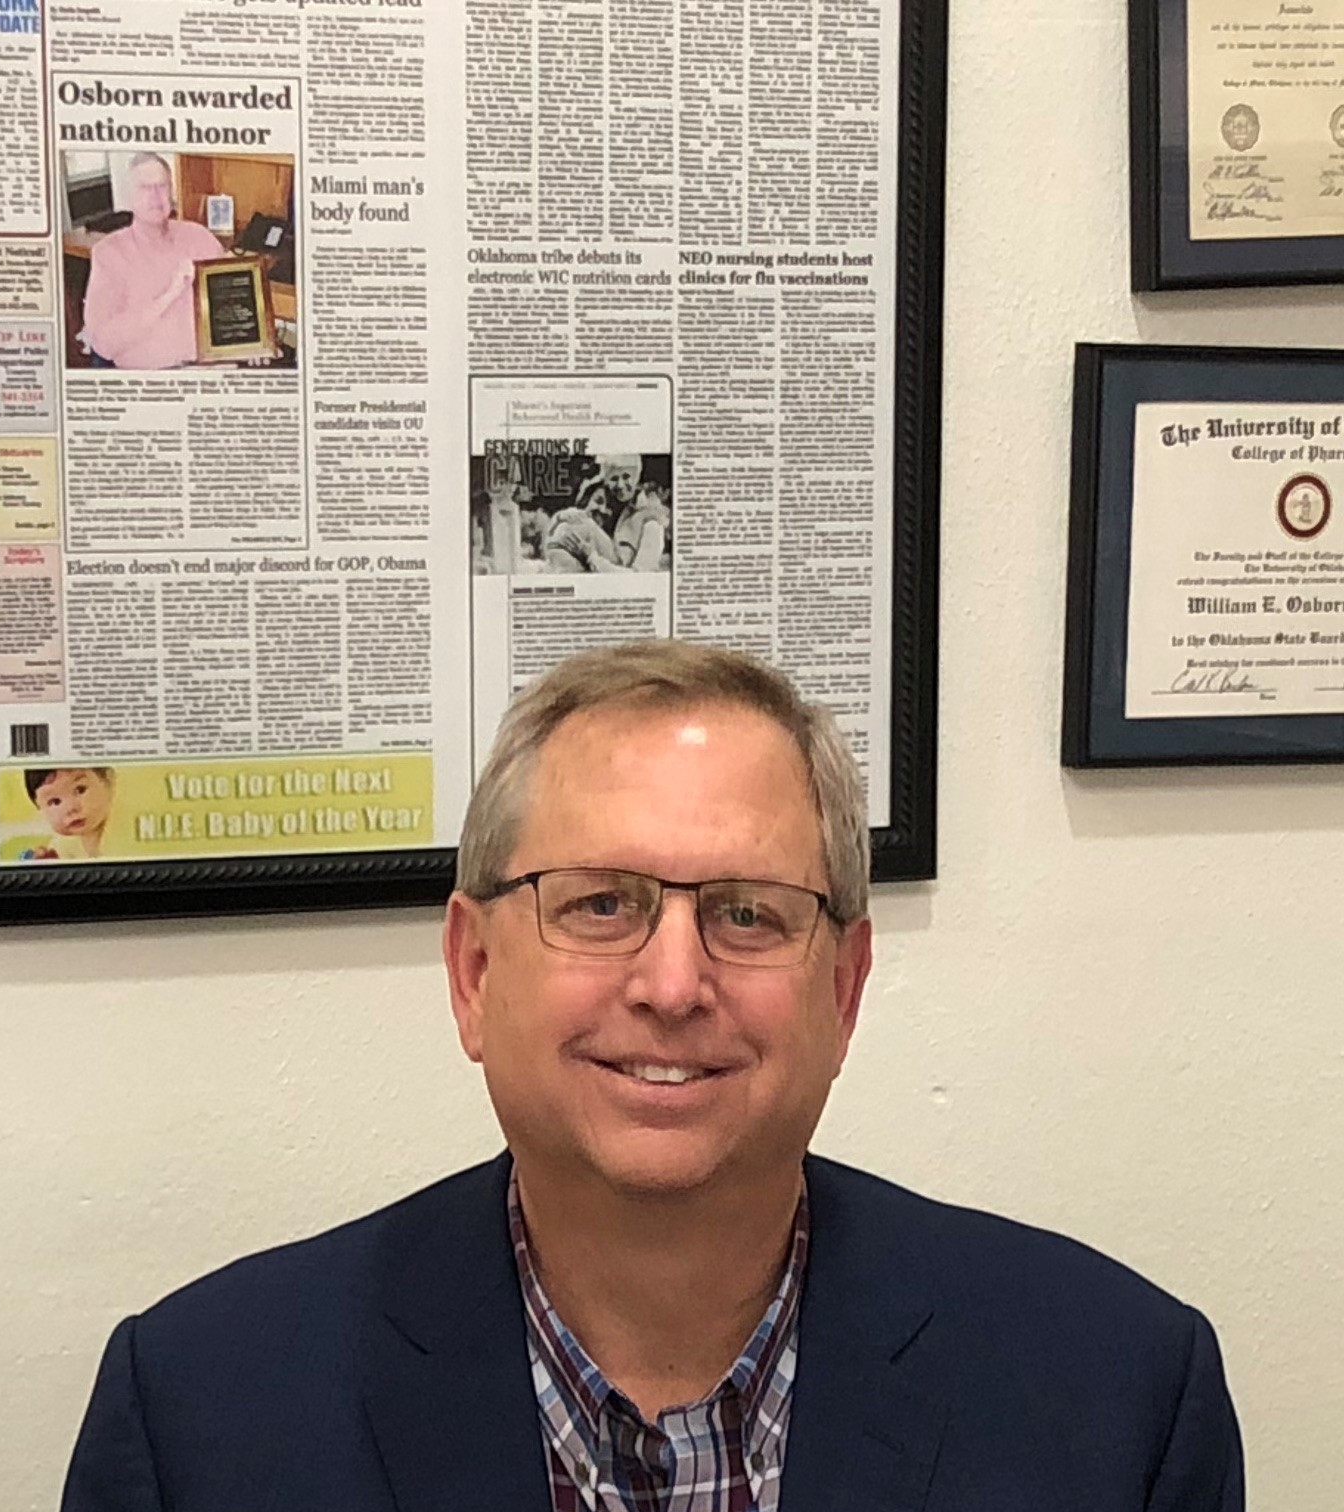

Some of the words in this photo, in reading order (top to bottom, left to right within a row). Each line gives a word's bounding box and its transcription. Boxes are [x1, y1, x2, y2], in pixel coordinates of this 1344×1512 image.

[58, 81, 163, 107] Osborn
[172, 83, 293, 110] awarded
[60, 118, 177, 143] national
[186, 120, 270, 145] honor
[311, 176, 367, 195] Miami
[373, 177, 424, 195] man's
[311, 201, 353, 224] body
[359, 202, 410, 222] found
[467, 249, 547, 265] Oklahoma
[551, 248, 575, 265] tribe
[578, 249, 623, 265] debuts
[626, 250, 642, 265] its
[679, 252, 713, 266] NEO
[716, 252, 773, 269] nursing
[777, 252, 838, 267] students
[843, 252, 873, 267] host
[467, 270, 534, 285] electronic
[538, 270, 569, 285] WIC
[573, 270, 632, 285] nutrition
[636, 270, 672, 286] cards
[679, 271, 725, 286] clinics
[730, 271, 752, 286] for
[756, 271, 776, 286] flu
[780, 272, 868, 286] vaccinations
[314, 401, 356, 413] Former
[360, 401, 426, 413] Presidential
[314, 417, 369, 430] candidate
[372, 418, 400, 429] visits
[403, 418, 424, 430] OU
[1160, 424, 1201, 447] The
[1207, 416, 1315, 440] University
[1320, 416, 1341, 435] of
[484, 438, 570, 456] GENERATIONS
[573, 438, 590, 456] OF
[1231, 445, 1286, 463] College
[1290, 445, 1305, 460] of
[484, 456, 572, 496] CARE
[67, 560, 125, 575] Election
[129, 559, 181, 575] doesn't
[184, 559, 211, 574] end
[214, 558, 255, 576] major
[259, 557, 310, 572] discord
[314, 556, 335, 571] for
[337, 557, 374, 573] GOP,
[377, 556, 427, 571] Obama
[1188, 596, 1256, 614] William
[1263, 595, 1282, 613] E.
[1172, 634, 1184, 646] to
[1187, 634, 1205, 647] the
[1209, 633, 1270, 647] Oklahoma
[1274, 632, 1306, 645] State
[167, 772, 229, 801] Vote
[235, 770, 277, 799] for
[282, 769, 326, 797] the
[332, 767, 391, 794] Next
[136, 813, 201, 842] N.I.E.
[205, 811, 274, 841] Baby
[279, 808, 308, 835] of
[312, 807, 357, 834] the
[366, 804, 423, 831] Year
